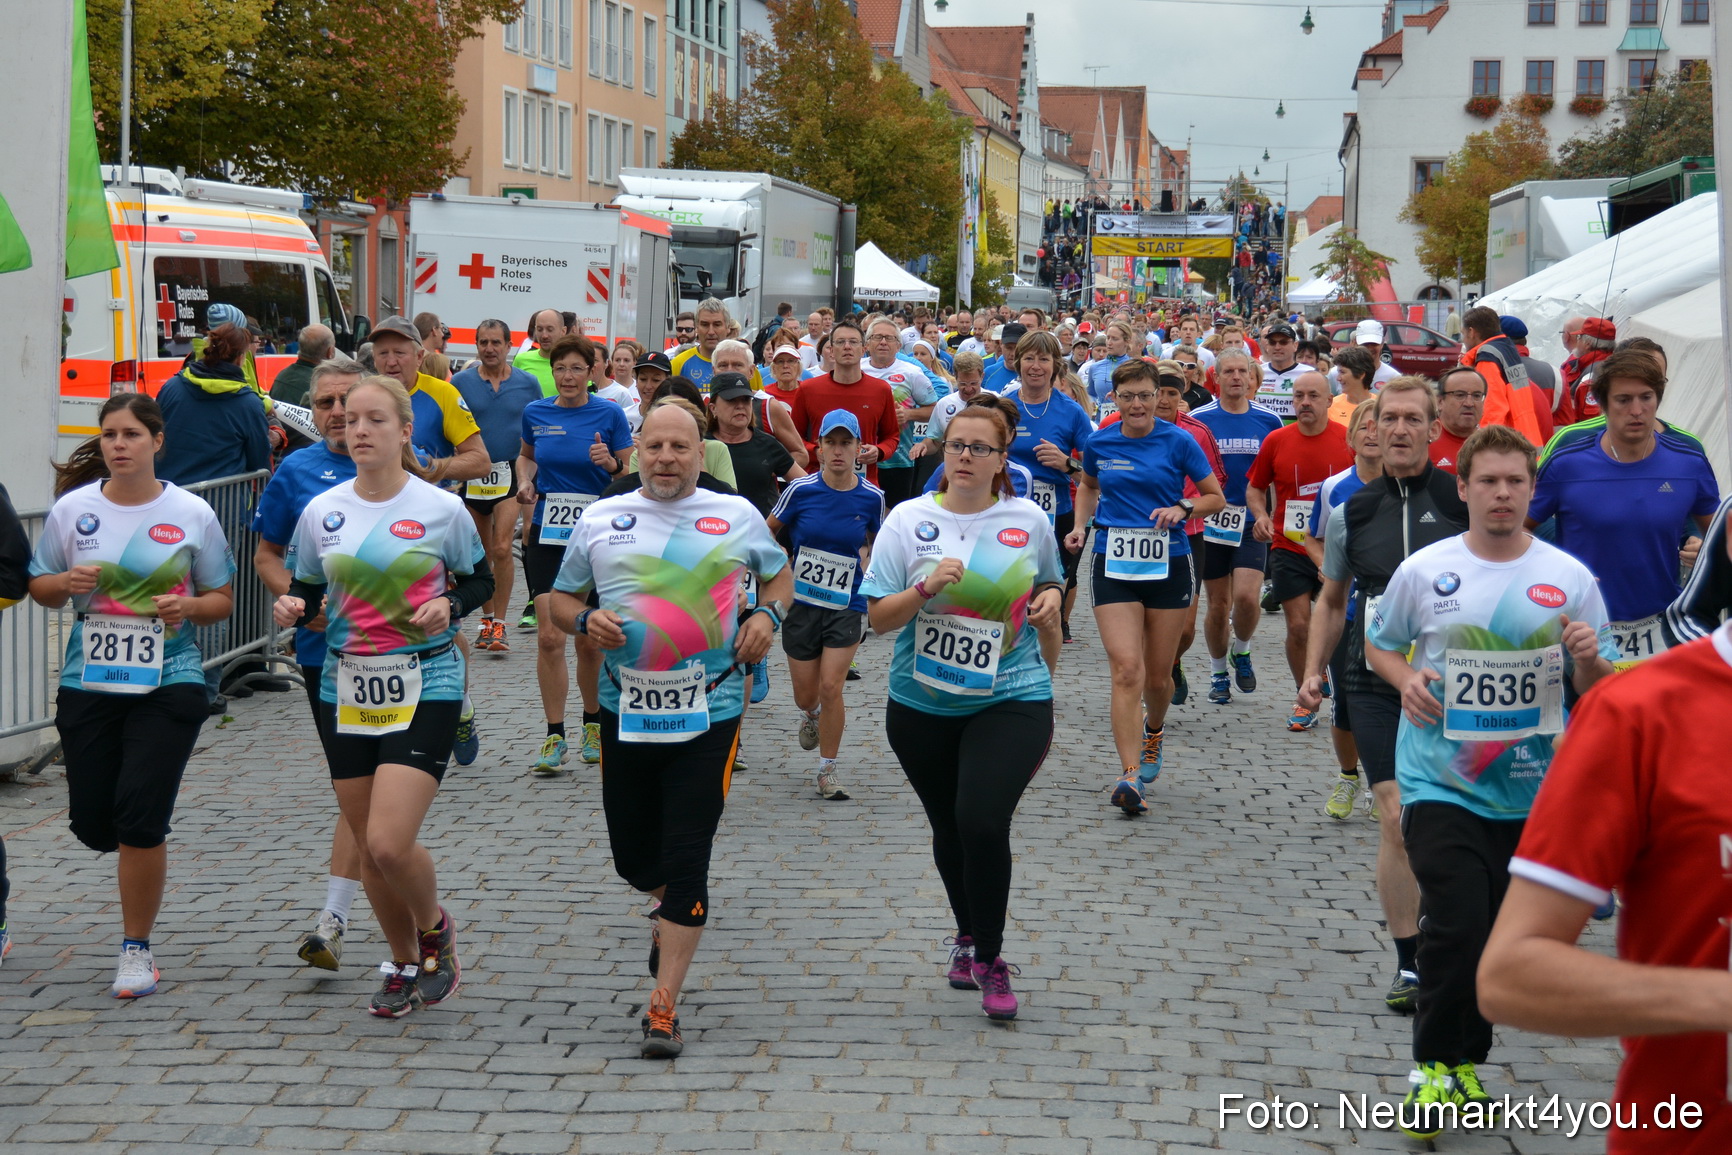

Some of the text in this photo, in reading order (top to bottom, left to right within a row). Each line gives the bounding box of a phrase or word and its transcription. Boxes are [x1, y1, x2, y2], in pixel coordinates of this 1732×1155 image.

[1136, 241, 1185, 253] START
[501, 255, 568, 268] Bayerisches
[501, 269, 532, 280] Rotes
[176, 285, 209, 301] Bayerisches
[500, 282, 532, 293] Kreuz
[859, 287, 903, 298] Laufsport
[178, 303, 195, 318] Rotes
[179, 323, 196, 337] Kreuz
[913, 424, 929, 436] 42
[1215, 438, 1260, 449] HUBER
[549, 505, 584, 526] 229
[1203, 511, 1241, 529] 469
[394, 523, 422, 535] Hervis
[700, 520, 727, 531] Hervis
[153, 527, 181, 540] Hervis
[322, 535, 341, 543] PARTL
[609, 533, 636, 541] PARTL
[1130, 529, 1159, 537] Neumarkt
[77, 538, 100, 546] PARTL
[916, 544, 942, 553] PARTL
[1113, 537, 1164, 560] 3100
[800, 550, 849, 567] PARTL Neumarkt
[799, 560, 850, 591] 2314
[807, 586, 832, 602] Nicole
[1532, 587, 1563, 602] Hervis
[1433, 599, 1460, 610] PARTL
[1434, 607, 1460, 615] Neumarkt
[85, 620, 150, 632] PARTL Neumarkt
[918, 615, 988, 636] PARTL Neumarkt
[1621, 619, 1656, 631] Neumarkt
[90, 632, 156, 664] 2813
[923, 627, 992, 670] 2038
[341, 660, 405, 672] PARTL Neumarkt
[1448, 657, 1530, 669] PARTL Neumarkt
[104, 669, 130, 681] Julia
[621, 672, 691, 686] PARTL Neumarkt
[935, 665, 966, 685] Sonja
[353, 674, 405, 706] 309
[1455, 671, 1537, 706] 2636
[628, 685, 699, 711] 2037
[360, 710, 399, 724] Simone
[642, 716, 687, 731] Norbert
[1473, 713, 1518, 728] Tobias
[1513, 744, 1532, 760] 16.
